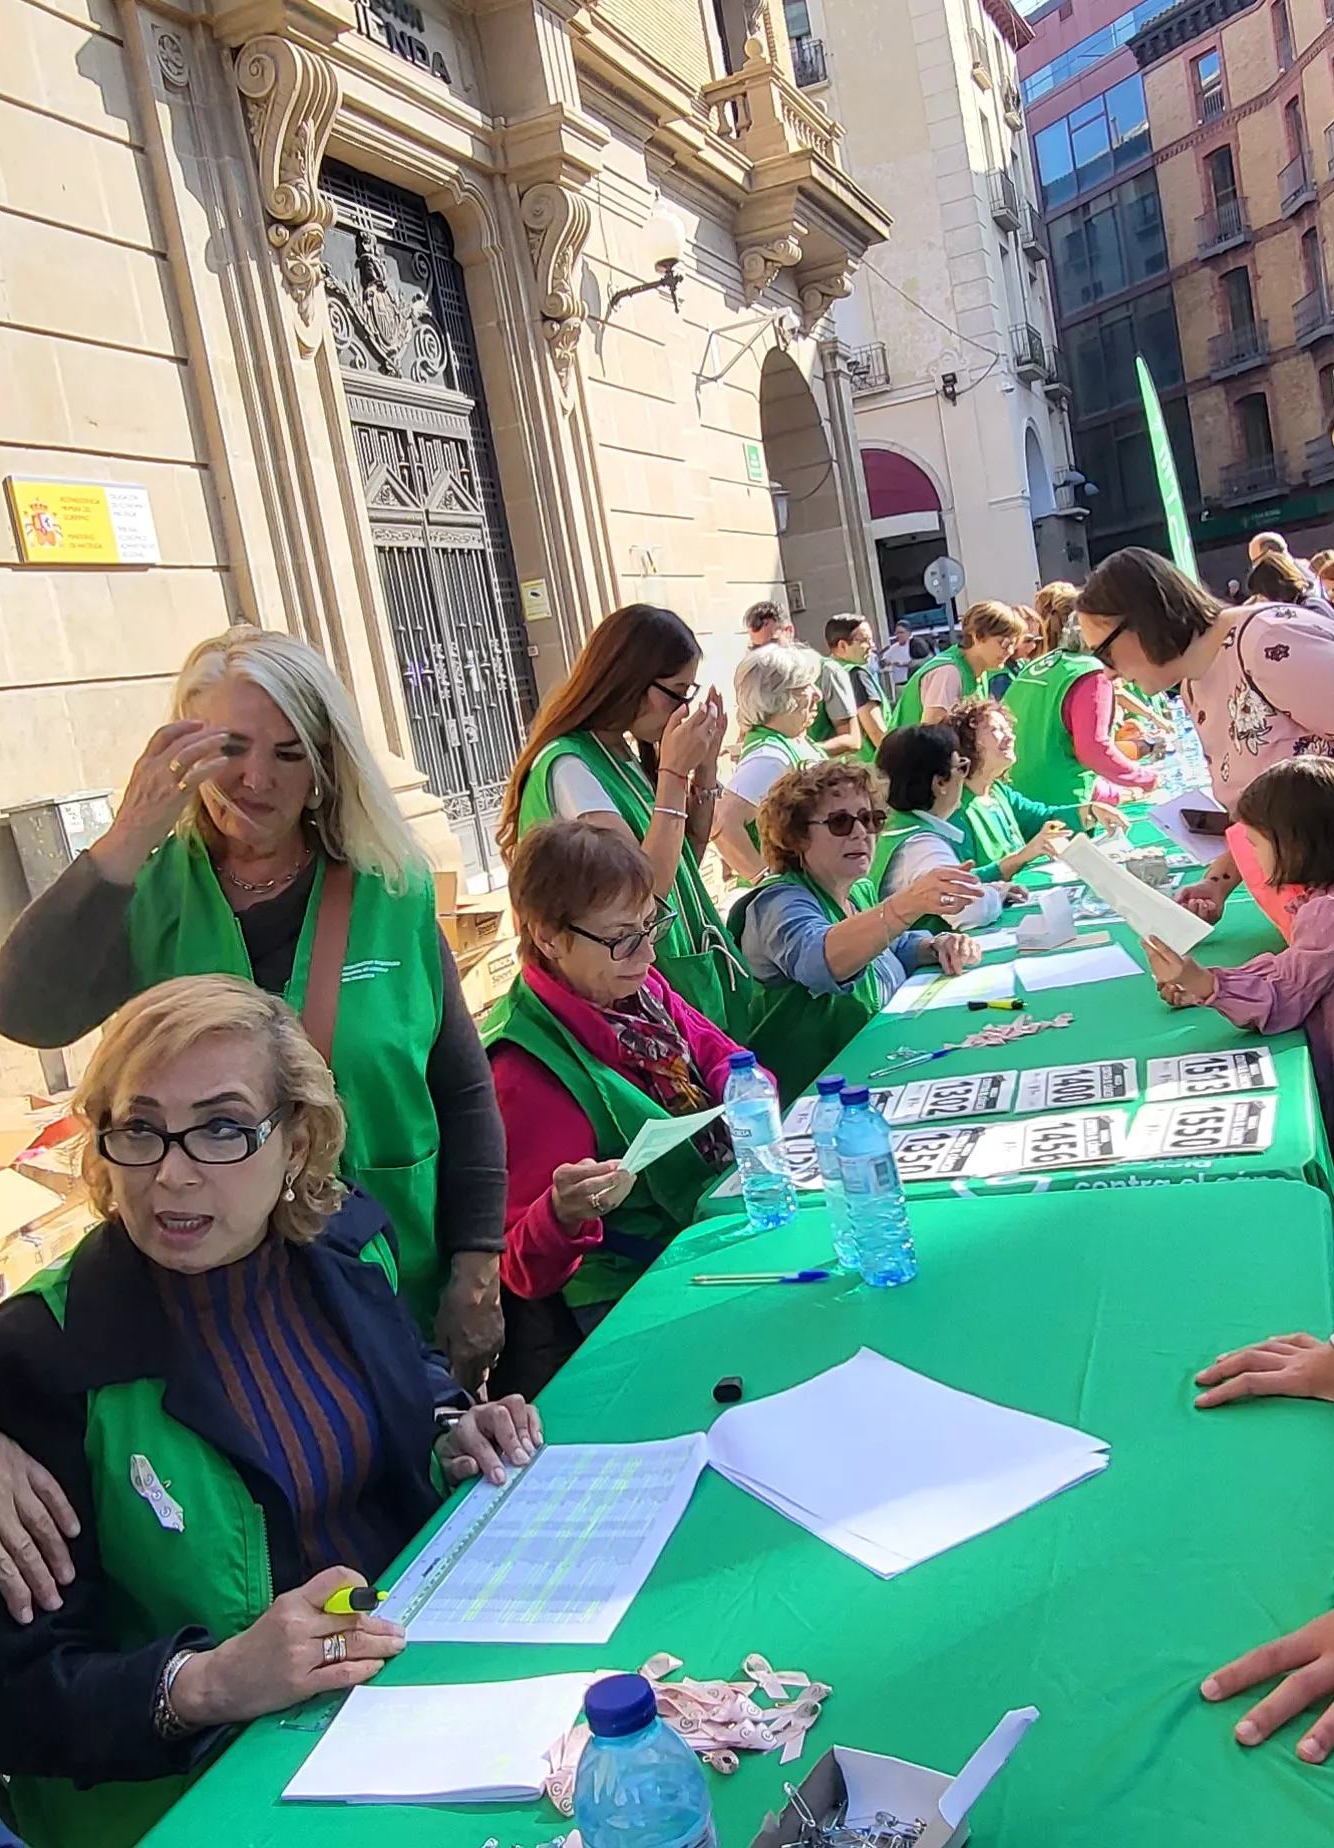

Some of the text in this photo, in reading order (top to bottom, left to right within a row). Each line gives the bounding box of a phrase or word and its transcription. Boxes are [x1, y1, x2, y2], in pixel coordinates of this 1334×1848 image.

[1052, 1069, 1095, 1103] 1400
[1184, 1057, 1231, 1093] 1513
[926, 1081, 974, 1116] 1302
[1030, 1122, 1078, 1163] 1456
[1170, 1106, 1226, 1148] 1550
[897, 1133, 952, 1175] 1350
